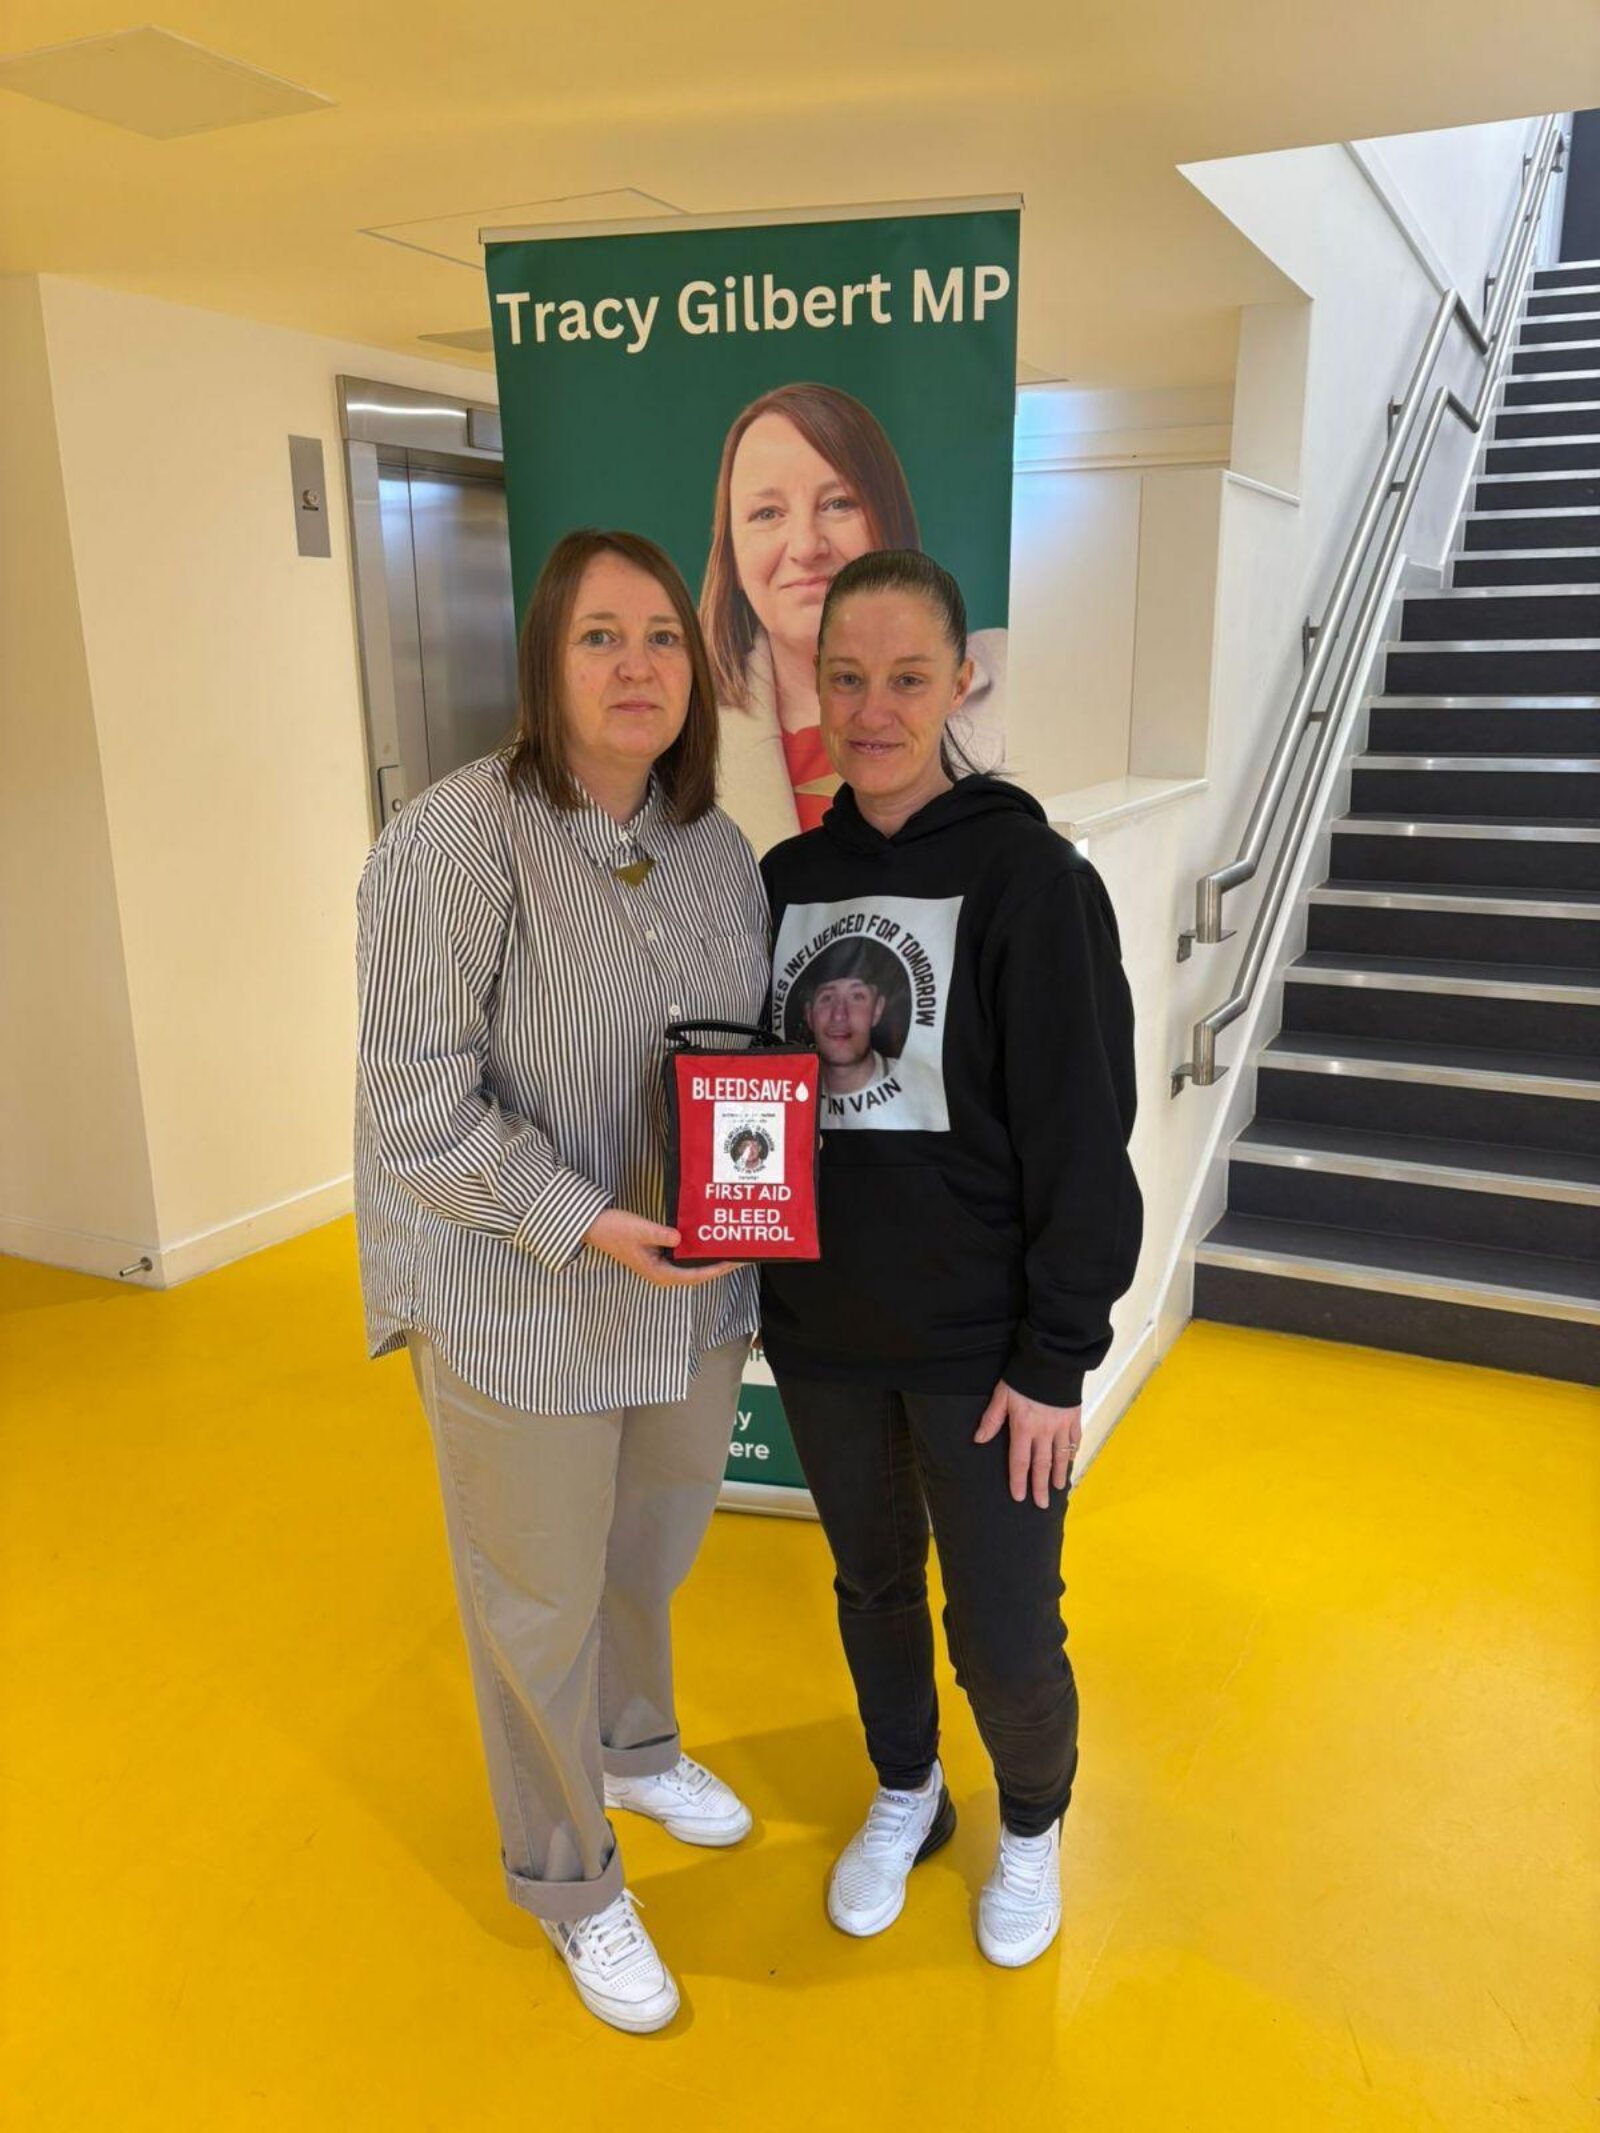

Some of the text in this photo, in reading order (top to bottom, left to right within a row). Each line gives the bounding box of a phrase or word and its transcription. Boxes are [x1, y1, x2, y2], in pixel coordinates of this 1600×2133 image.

[496, 265, 1010, 354] Tracy Gilbert MP
[773, 913, 936, 1032] LIVES INFLUENCED FOR TOMORROW
[692, 1077, 792, 1101] BLEEDSAVE
[827, 1077, 902, 1115] IN VAIN
[705, 1183, 791, 1201] FIRST AID
[714, 1209, 780, 1224] BLEED
[698, 1226, 794, 1242] CONTROL
